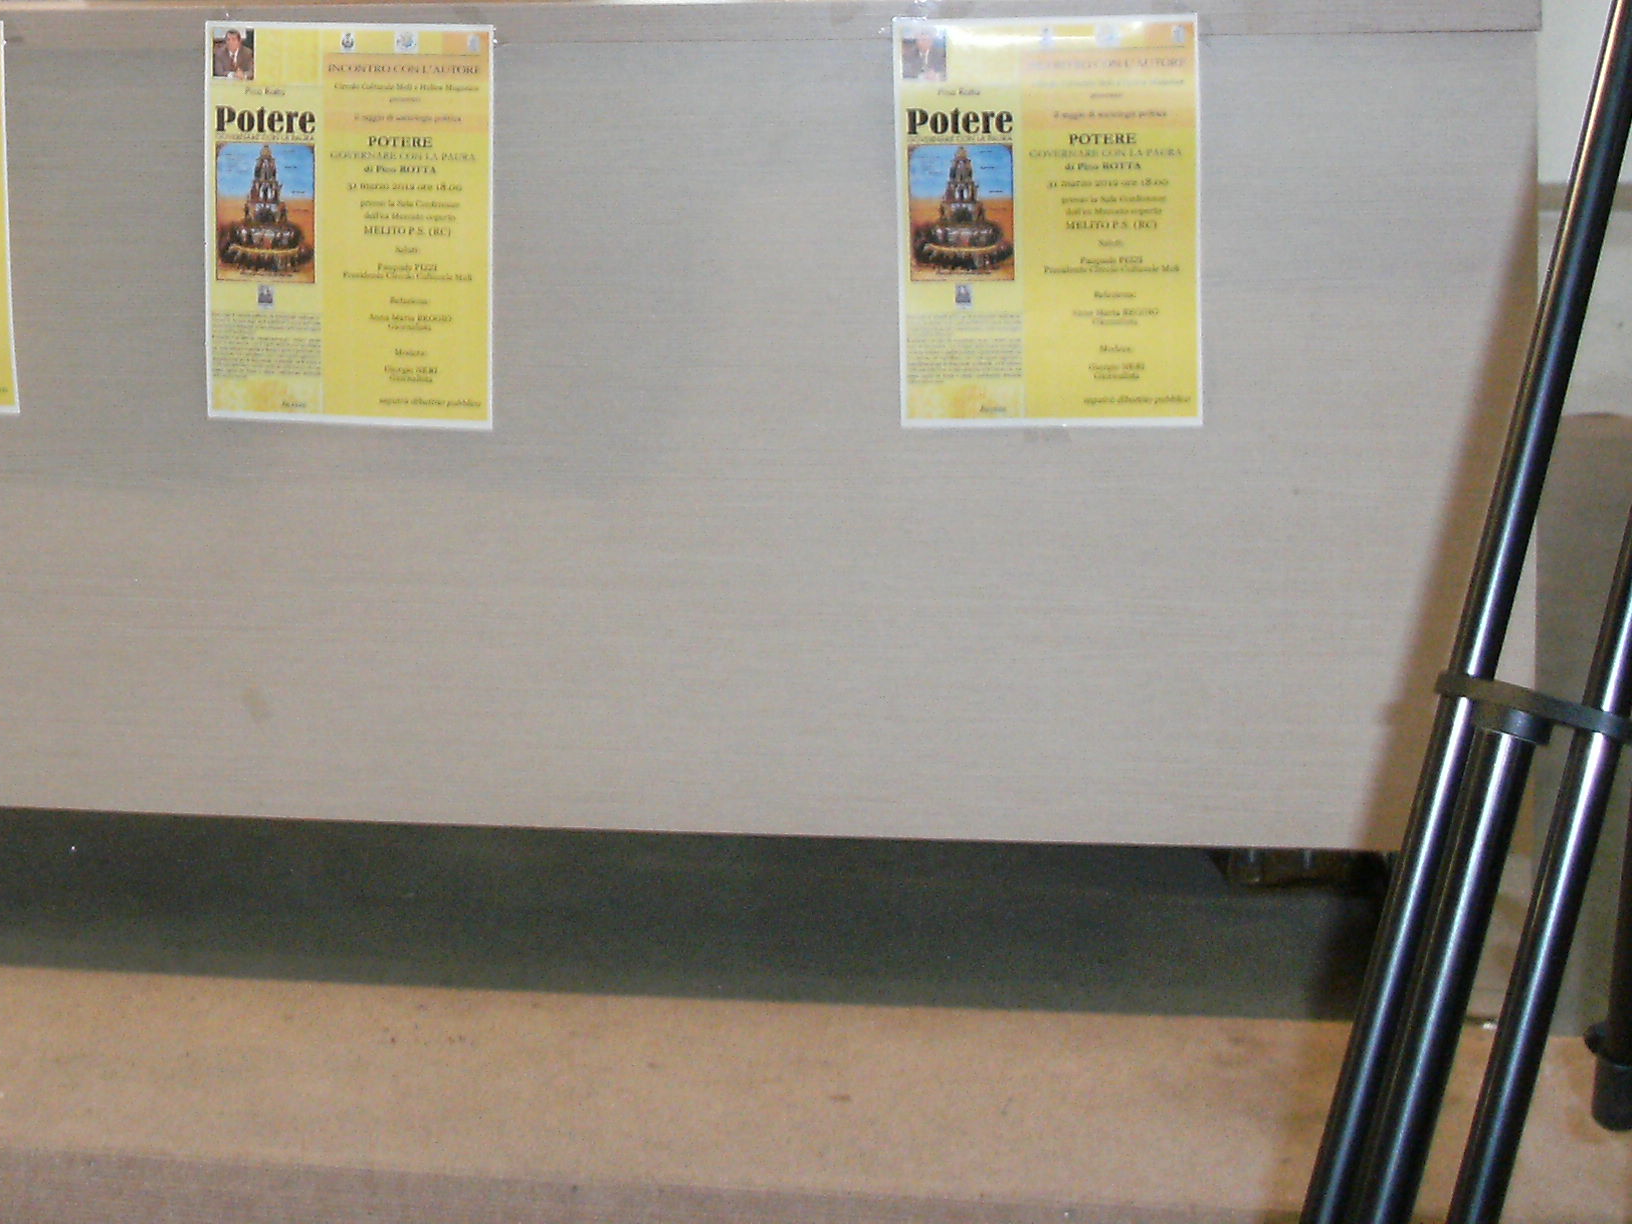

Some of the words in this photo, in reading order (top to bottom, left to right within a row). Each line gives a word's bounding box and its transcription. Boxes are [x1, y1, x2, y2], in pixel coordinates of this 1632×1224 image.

[216, 106, 315, 133] Potere
[907, 107, 1013, 134] Potere
[369, 136, 433, 148] POTERE
[1070, 133, 1137, 145] POTERE
[400, 166, 437, 174] ROTTA
[365, 226, 406, 236] MELITO
